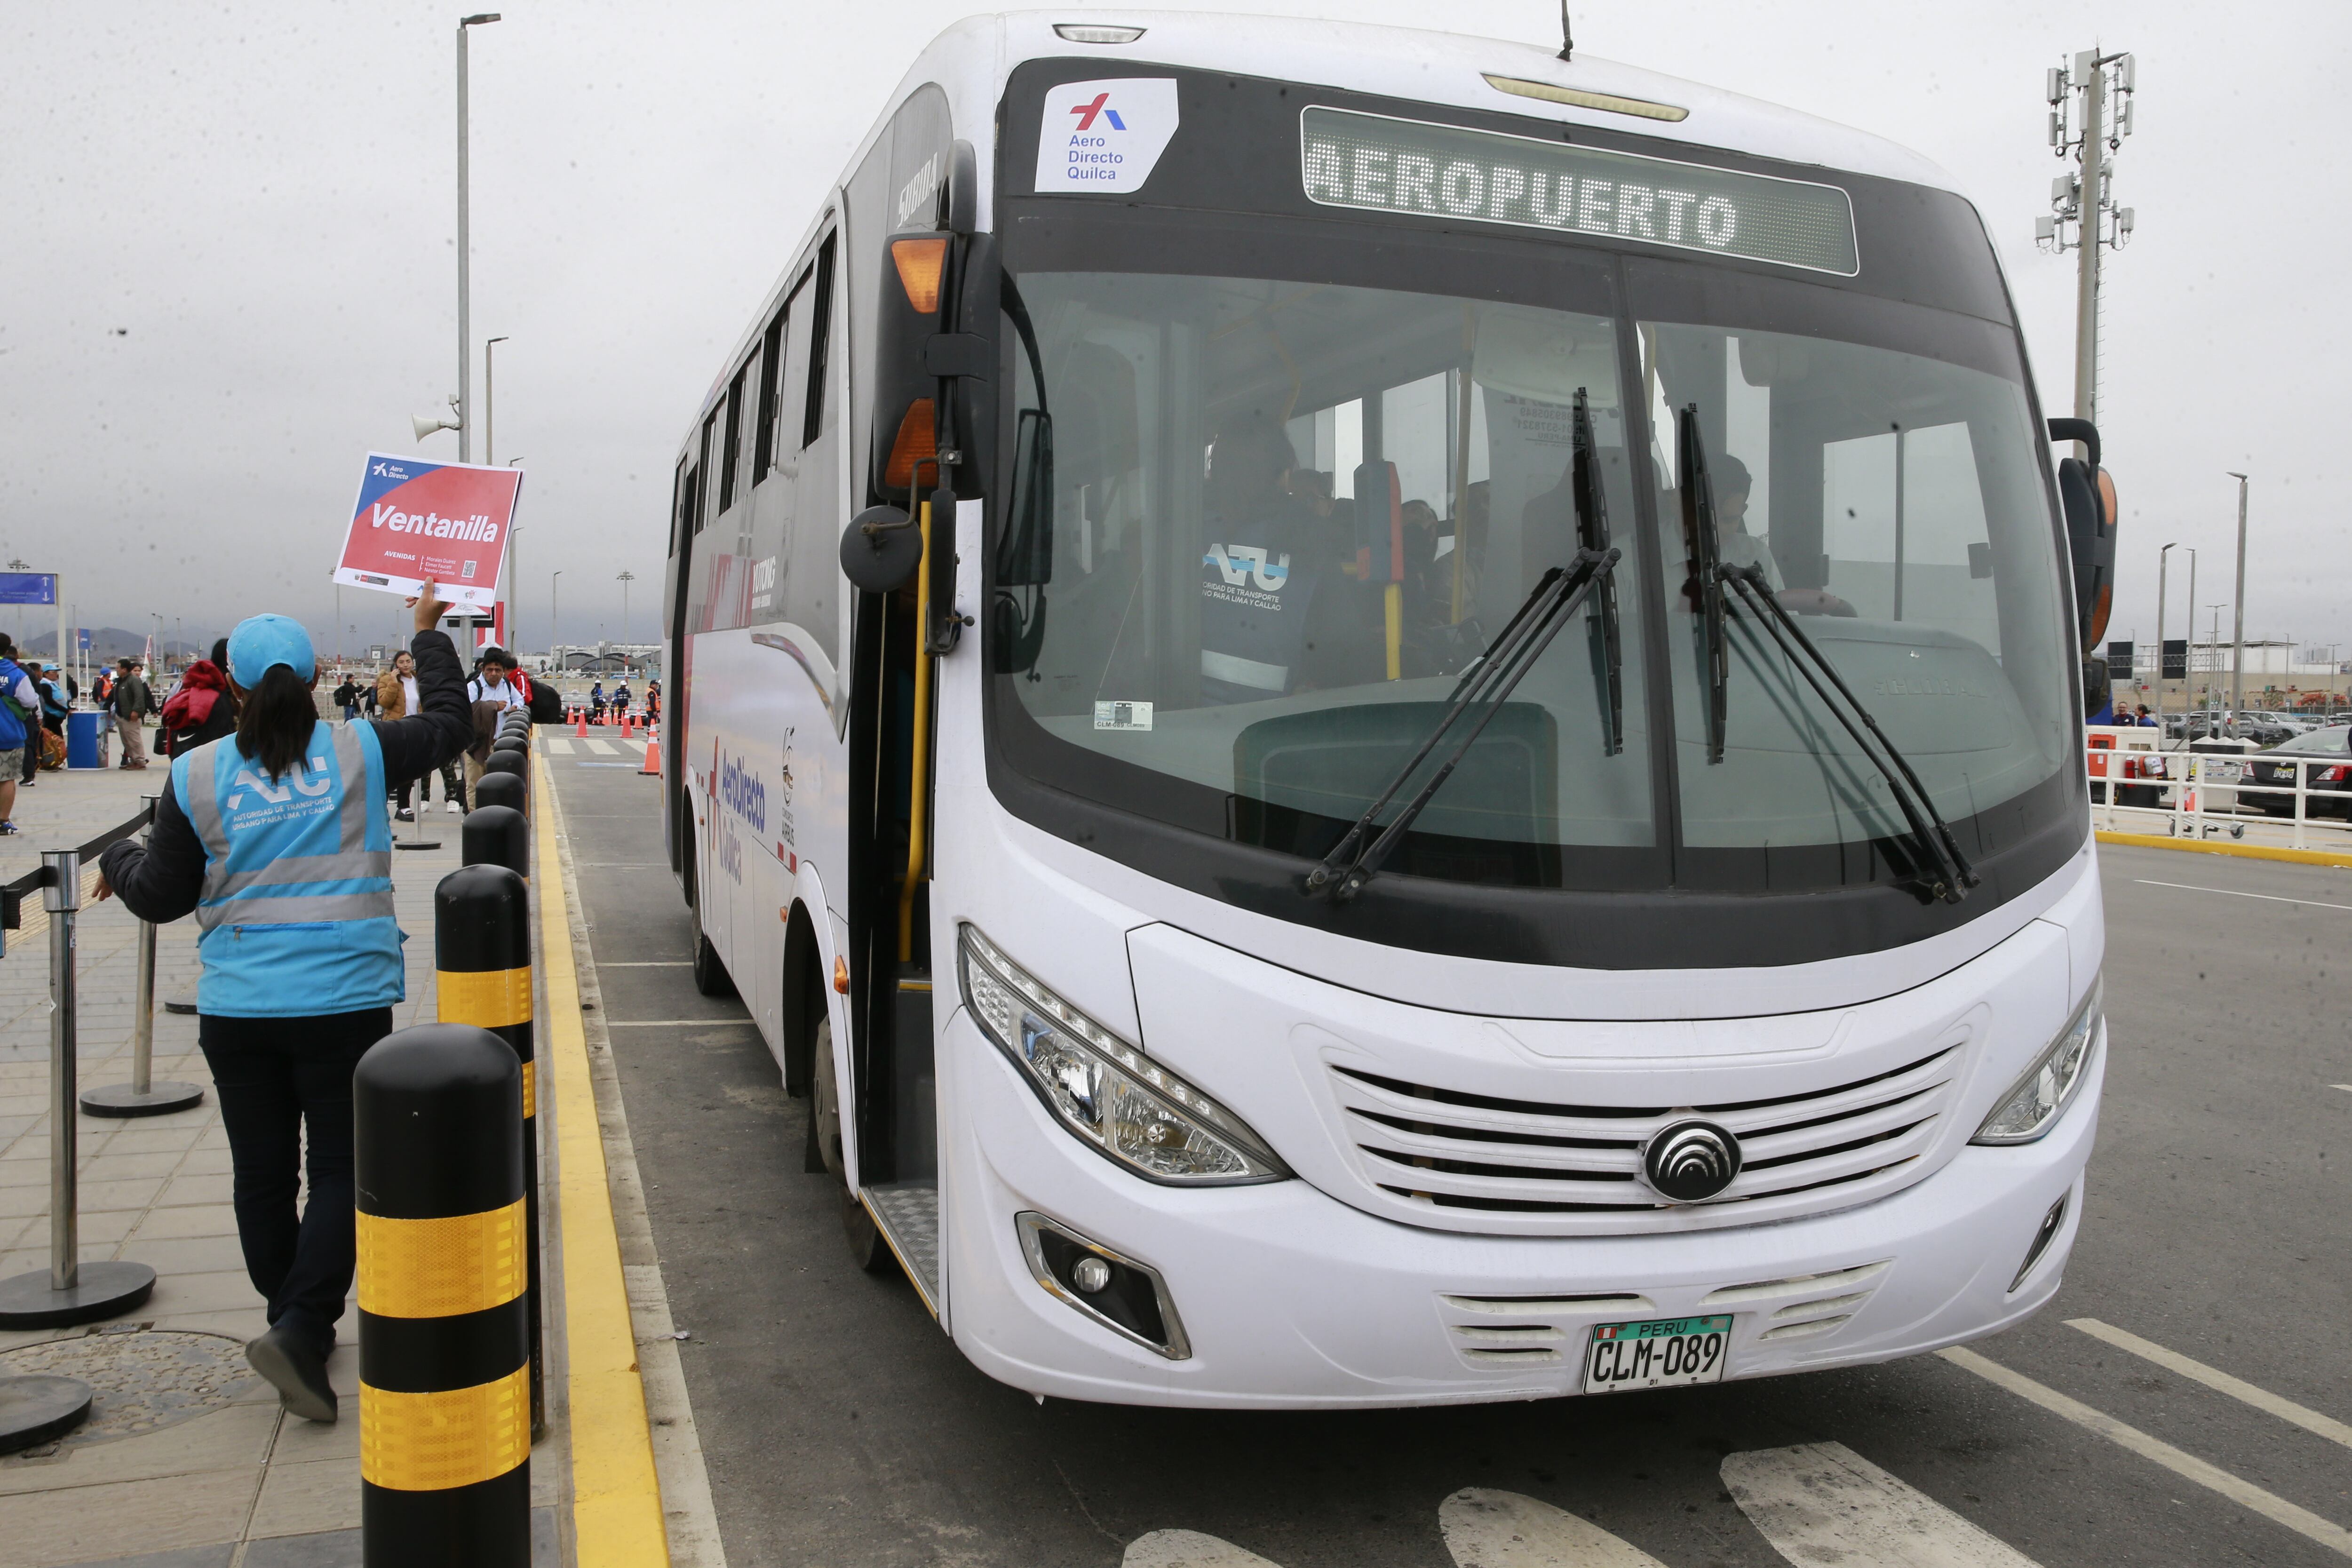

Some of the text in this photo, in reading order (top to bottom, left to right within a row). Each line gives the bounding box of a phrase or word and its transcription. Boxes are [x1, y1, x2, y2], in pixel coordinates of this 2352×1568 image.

[1069, 135, 1105, 147] Aero
[1068, 151, 1123, 163] Directo
[1067, 167, 1116, 180] Quilca
[897, 152, 938, 229] SUBIDA
[1305, 142, 1738, 247] AEROPUERTO
[372, 502, 498, 542] Ventanilla
[384, 550, 415, 560] AVENIDAS
[1202, 543, 1290, 591] ATU
[753, 555, 776, 593] YUTONG
[1213, 592, 1230, 601] PARA
[1255, 600, 1281, 611] CALLAO
[1237, 589, 1279, 603] TRANSPORTE
[723, 748, 765, 834] AeroDirecto
[233, 808, 273, 822] AUTORIDAD
[286, 796, 332, 811] TRANSPORTE
[233, 819, 260, 830] URBANO
[262, 815, 282, 824] PARA
[723, 815, 742, 886] Quilca
[1639, 1321, 1688, 1337] PERU
[1593, 1333, 1721, 1382] CLM-089
